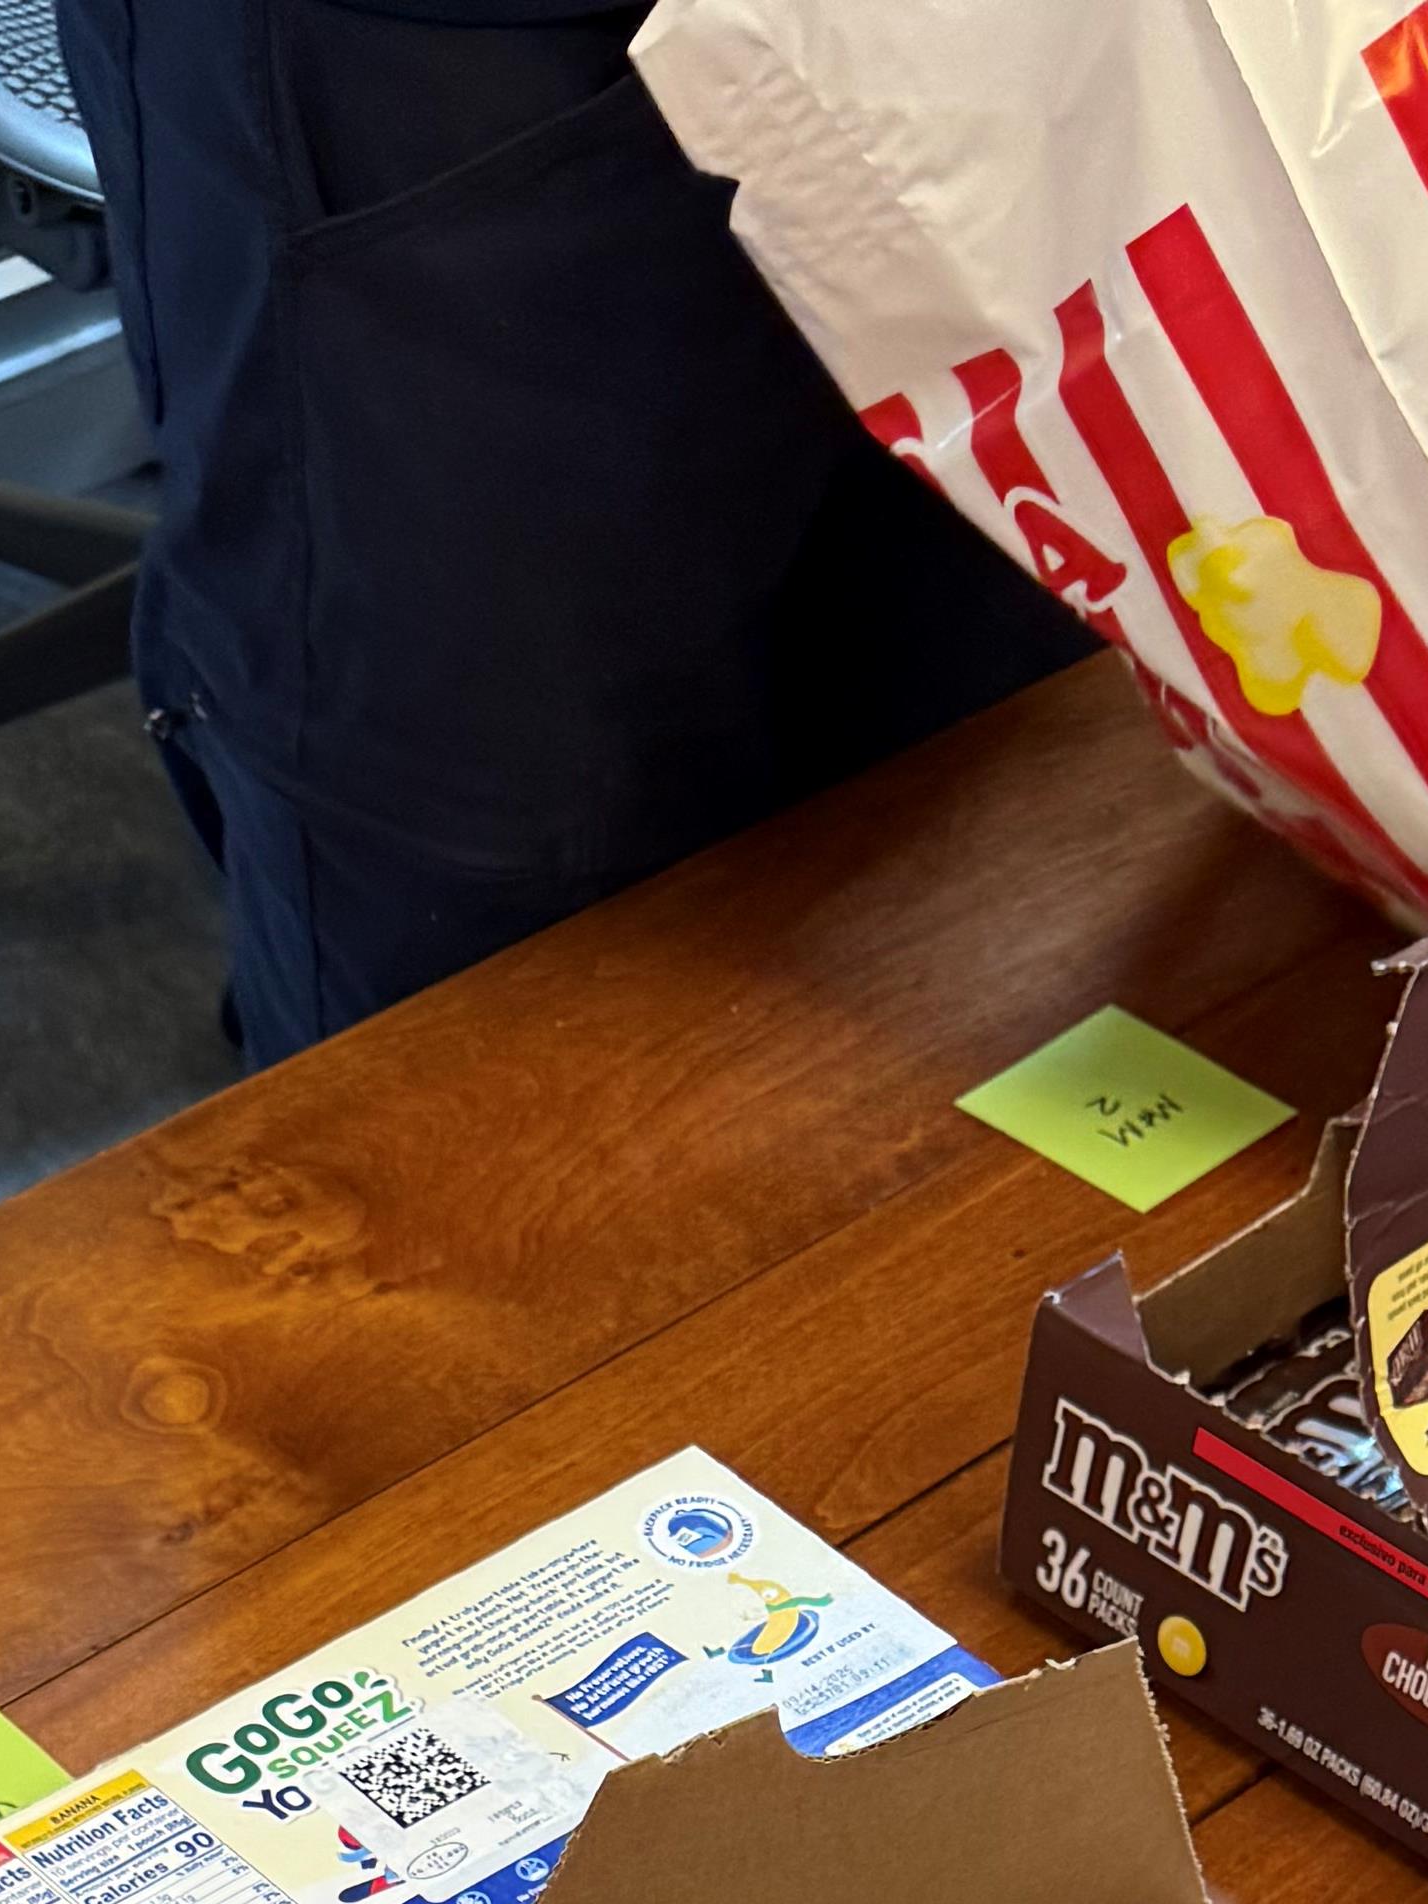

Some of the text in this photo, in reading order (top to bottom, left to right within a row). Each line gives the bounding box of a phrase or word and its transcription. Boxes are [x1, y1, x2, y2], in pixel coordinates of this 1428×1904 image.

[1035, 1527, 1144, 1614] 36 COUNT
[1396, 1557, 1428, 1591] para
[184, 1680, 354, 1796] GoGo
[266, 1691, 413, 1780] SQUEEZ
[1320, 1746, 1362, 1788] PACKS
[31, 1794, 169, 1869] Nutrition Facts
[174, 1831, 214, 1858] 90
